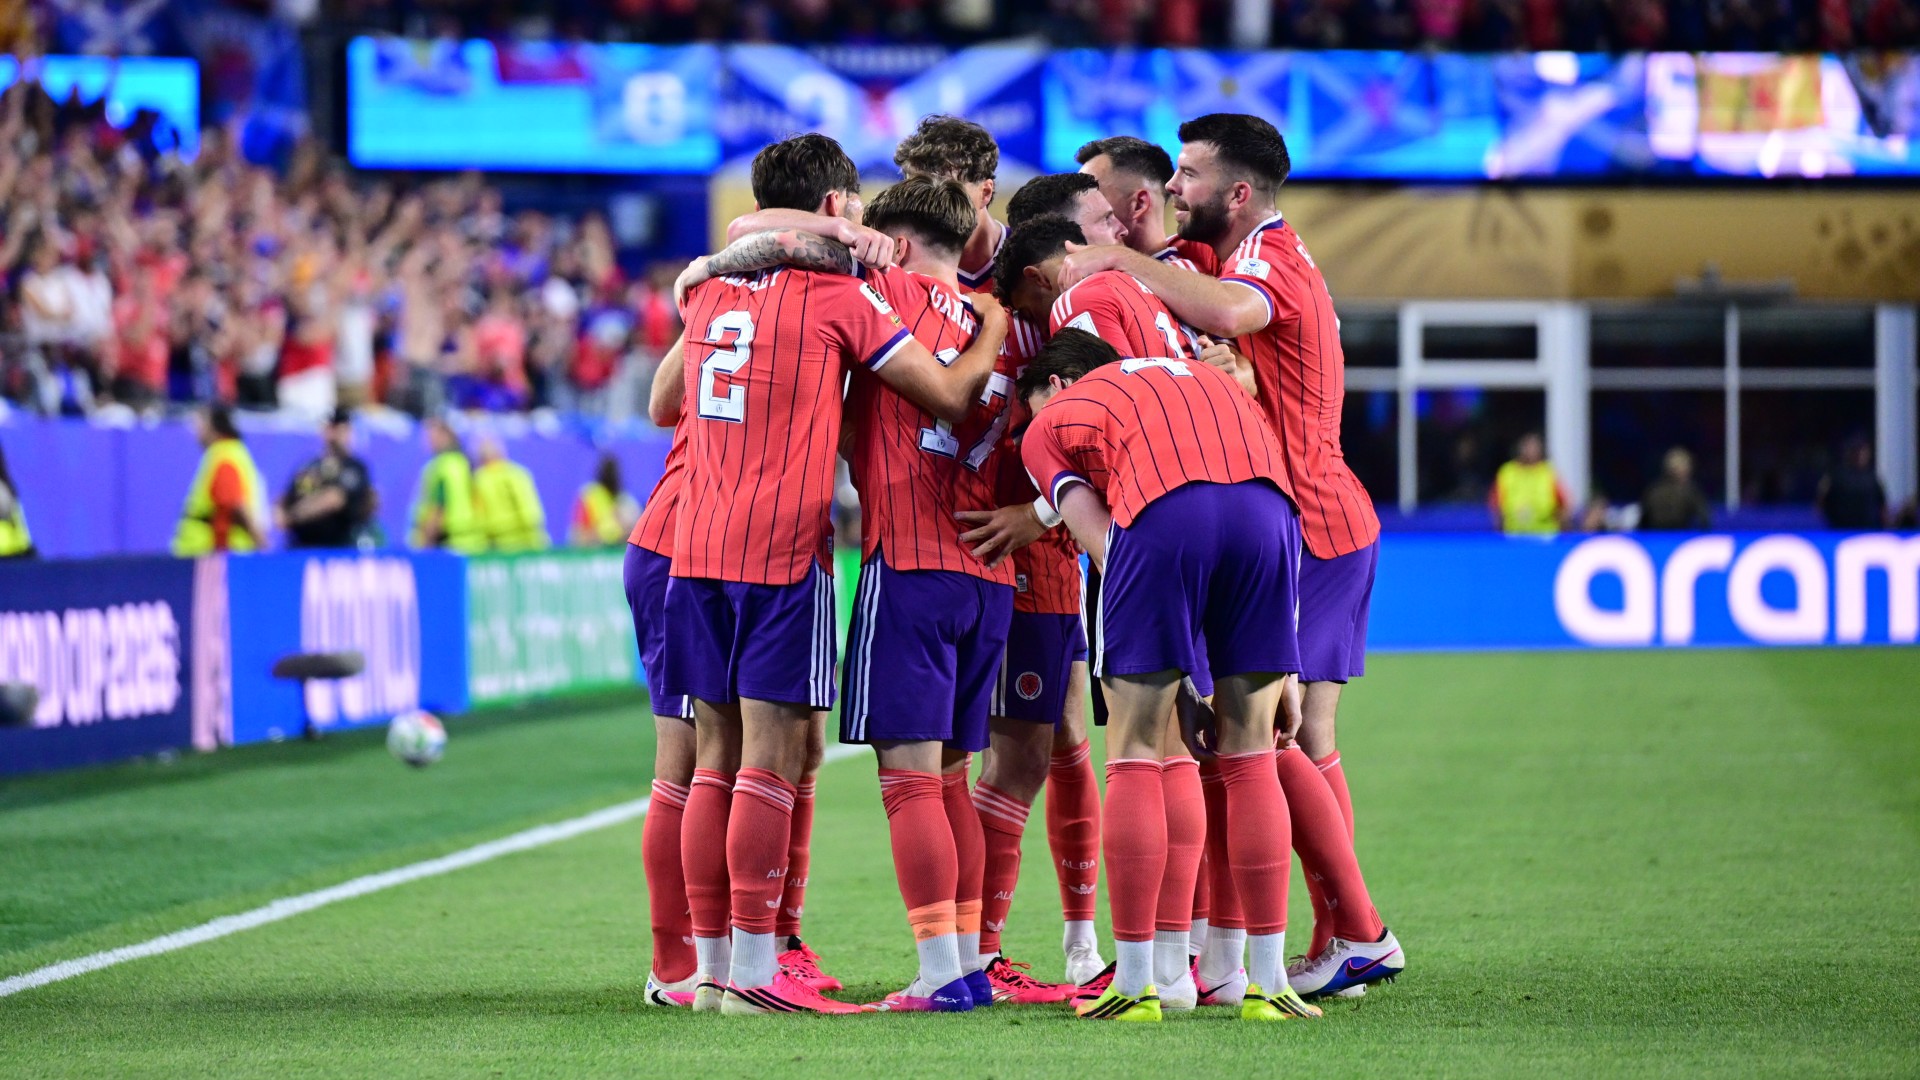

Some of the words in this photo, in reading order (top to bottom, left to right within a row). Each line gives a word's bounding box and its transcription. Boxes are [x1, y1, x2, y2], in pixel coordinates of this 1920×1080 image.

[698, 310, 755, 424] 2
[919, 347, 1016, 473] 17
[788, 877, 809, 888] ALB
[1061, 859, 1096, 870] ALBA
